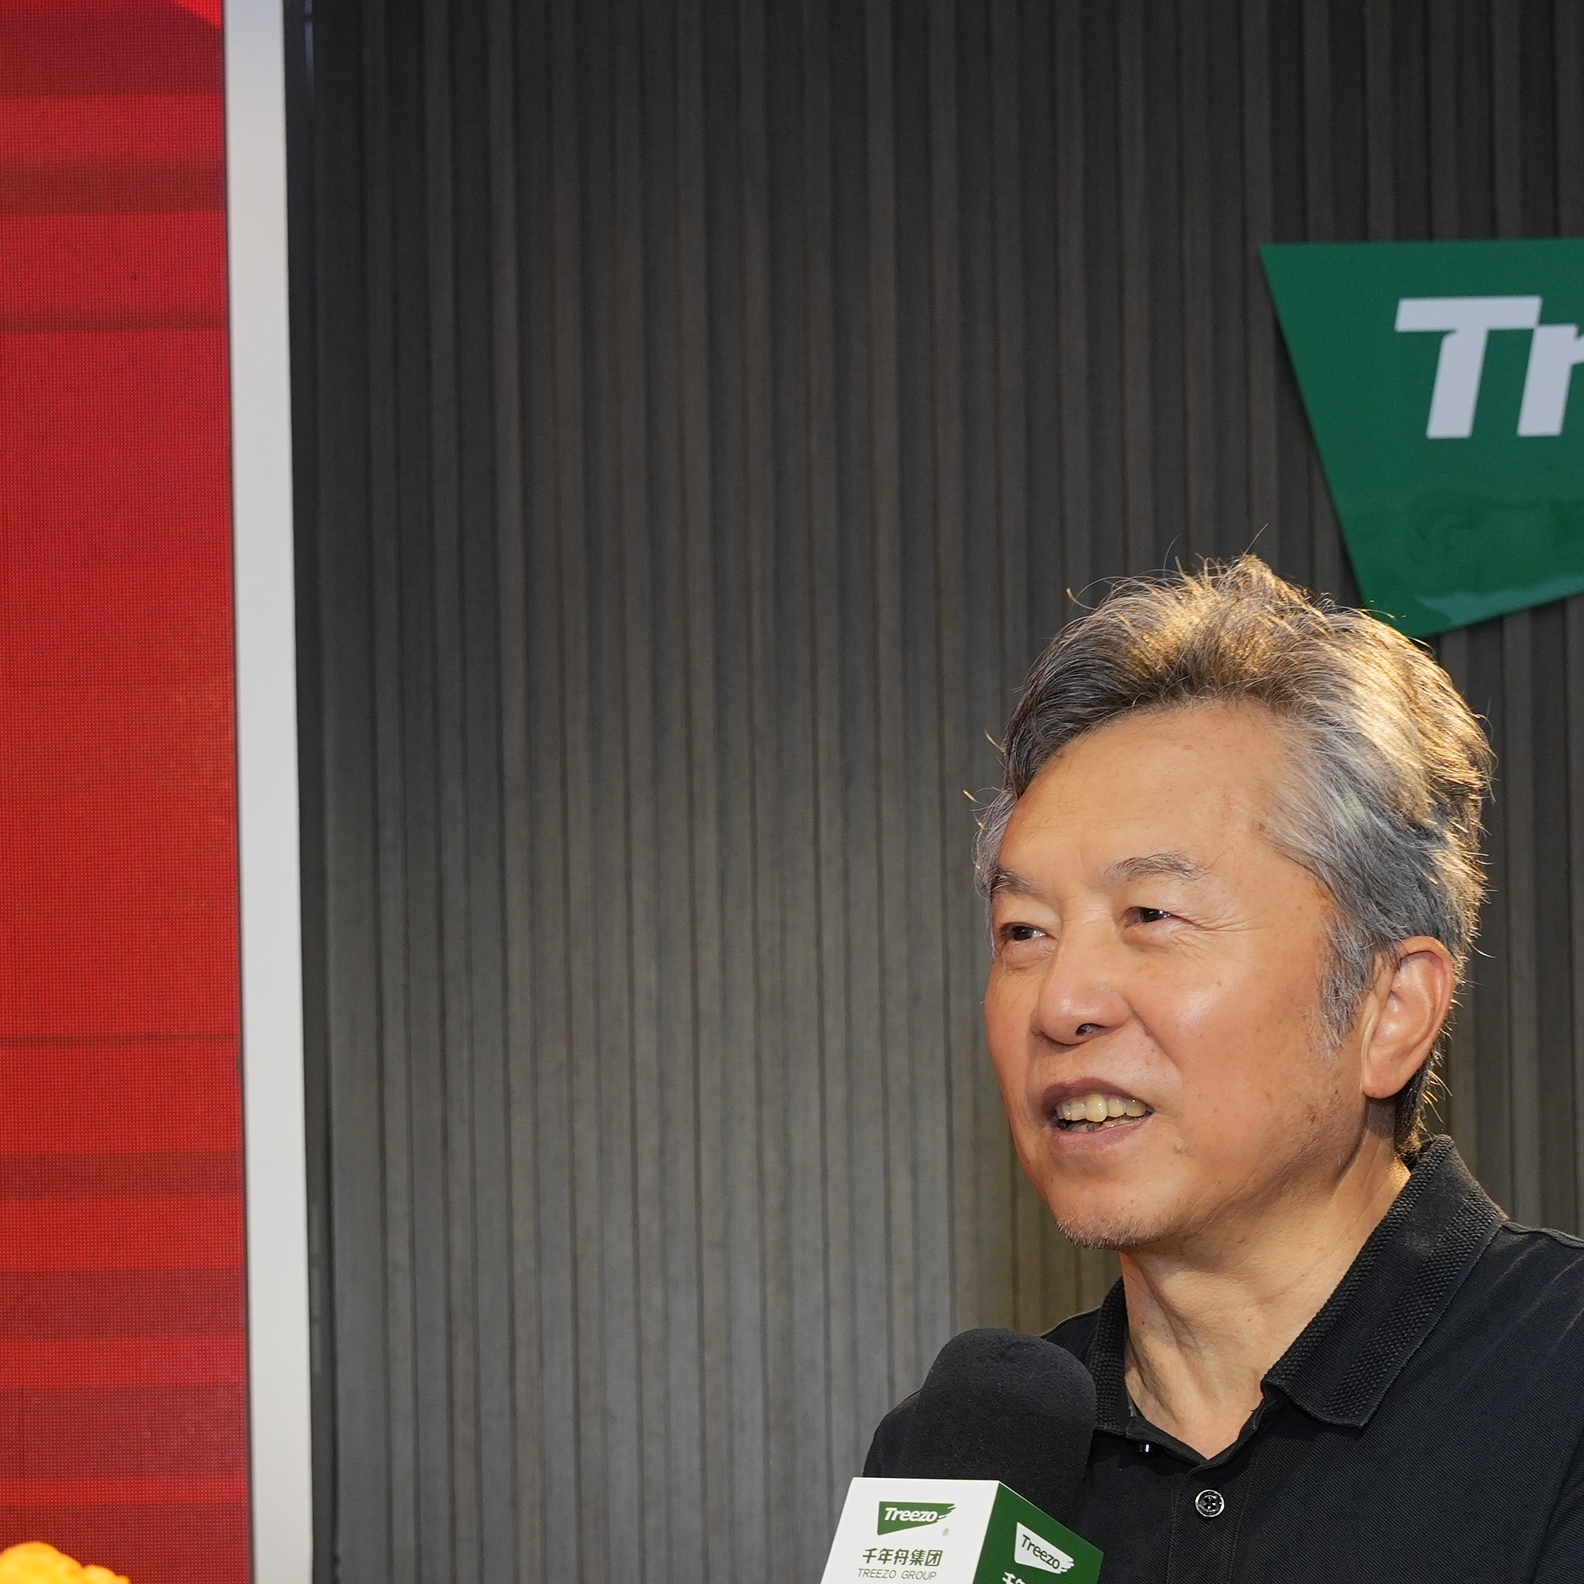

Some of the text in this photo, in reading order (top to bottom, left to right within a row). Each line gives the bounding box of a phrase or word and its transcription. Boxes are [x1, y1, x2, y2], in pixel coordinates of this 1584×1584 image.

[884, 1507, 938, 1523] Treezo
[862, 1547, 944, 1567] 千年舟集团
[1021, 1533, 1061, 1570] Treezo
[857, 1568, 938, 1581] TREEZO GROUP
